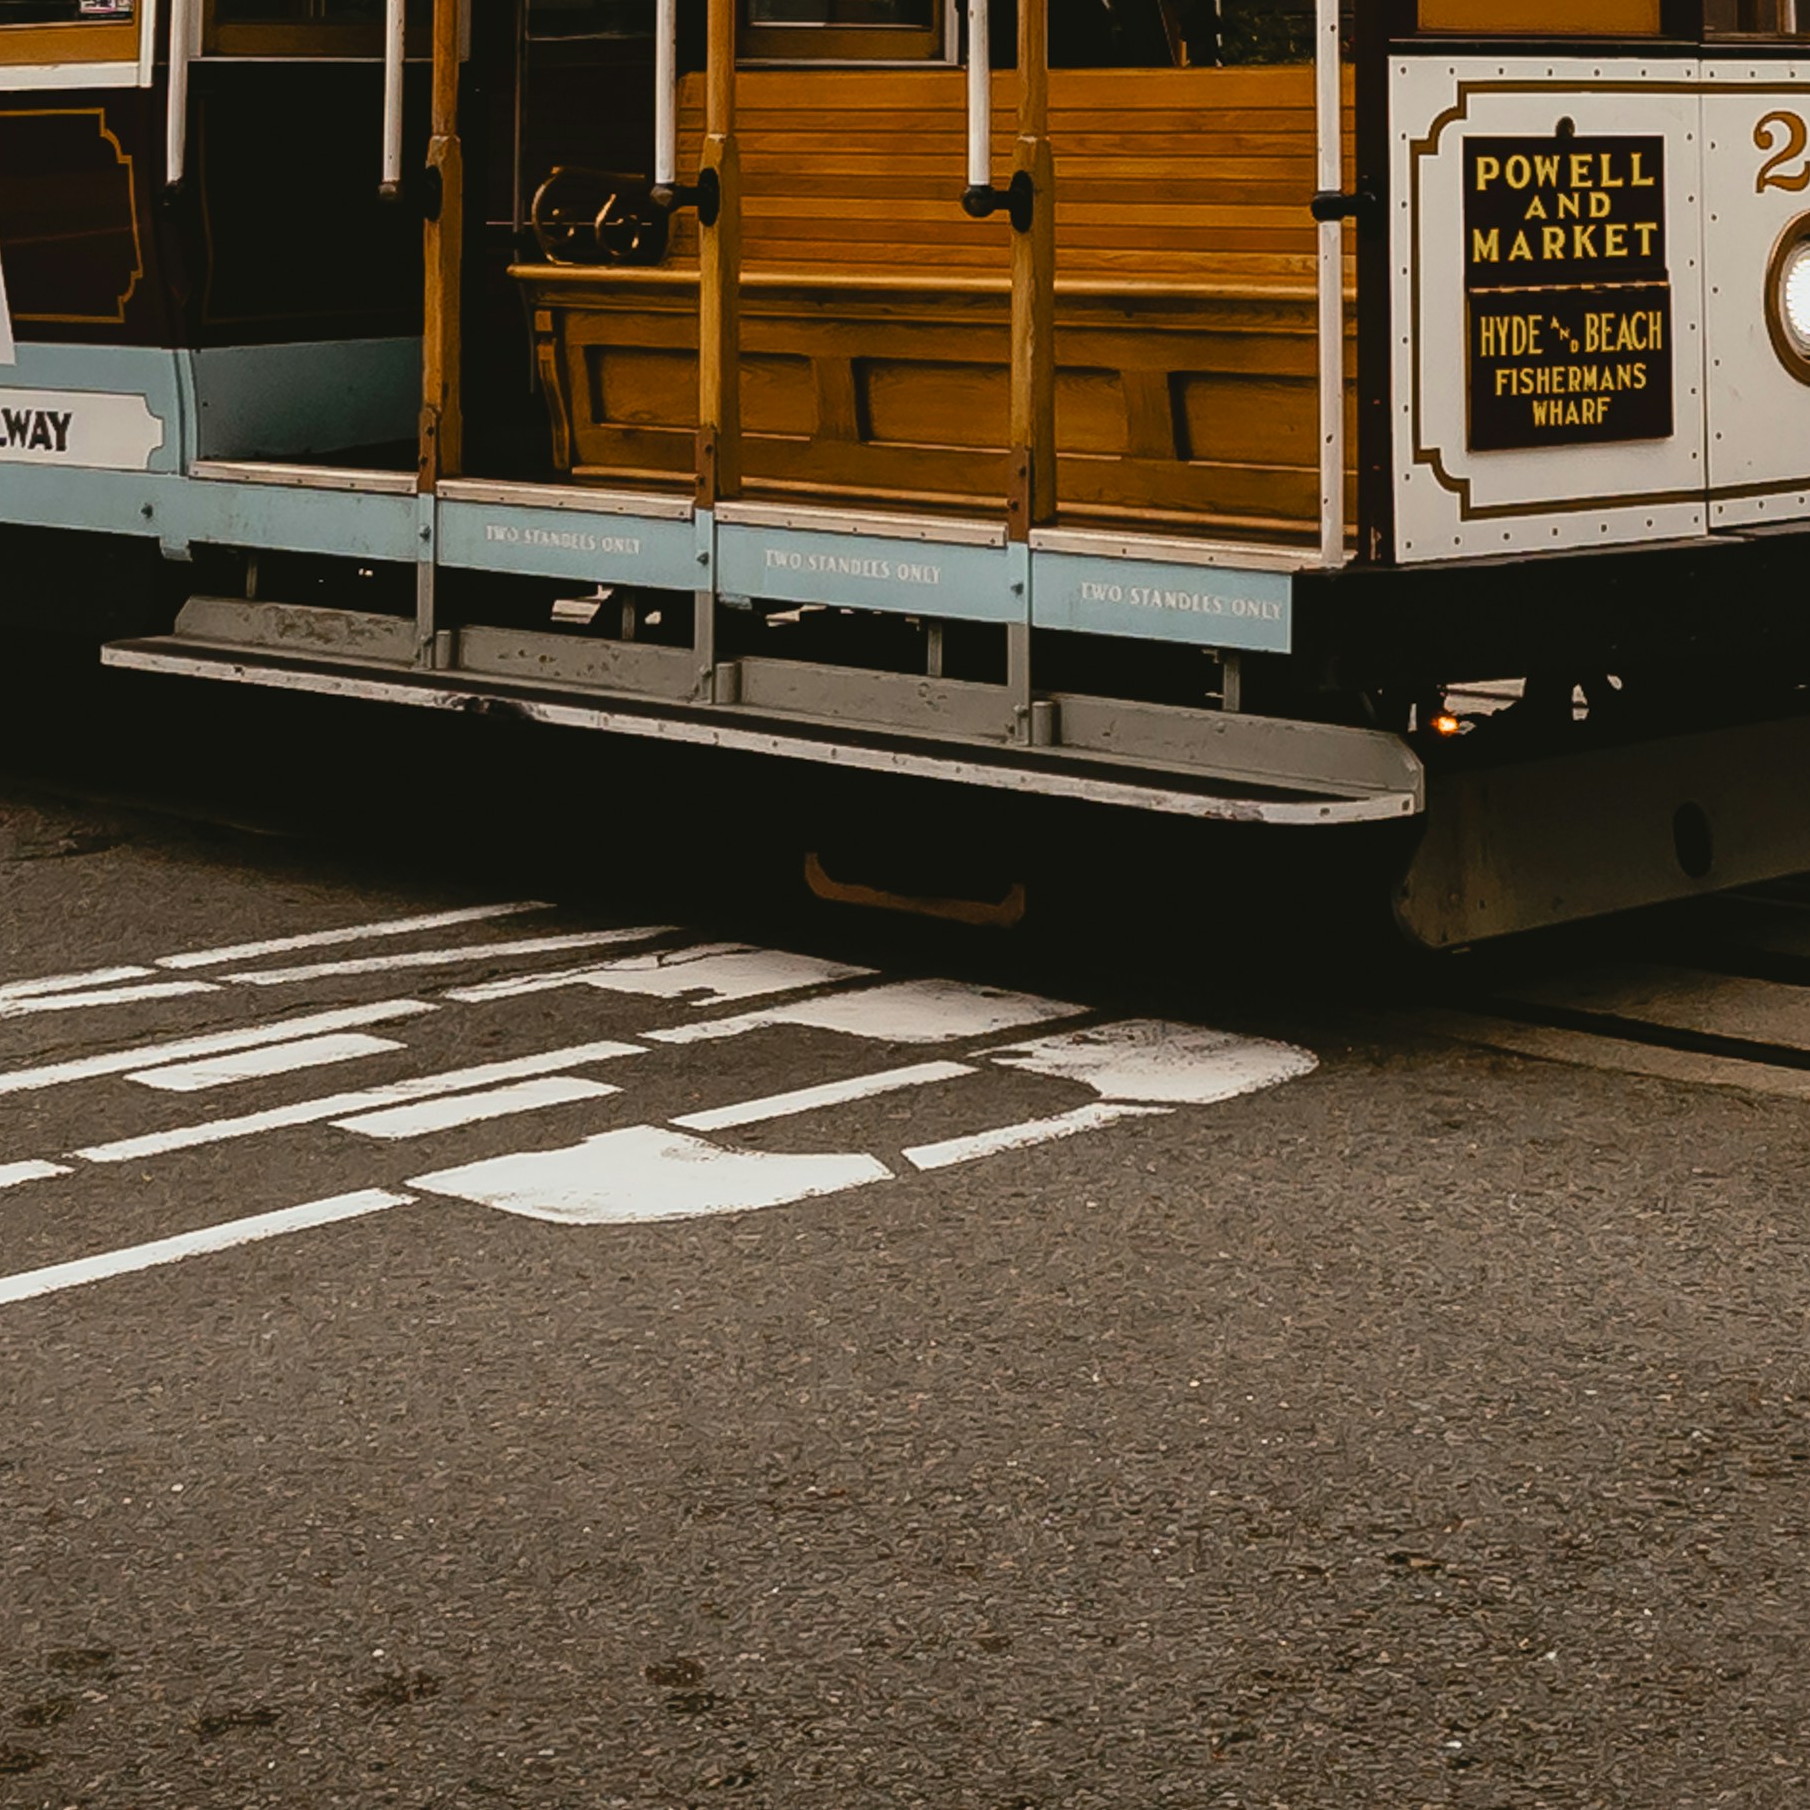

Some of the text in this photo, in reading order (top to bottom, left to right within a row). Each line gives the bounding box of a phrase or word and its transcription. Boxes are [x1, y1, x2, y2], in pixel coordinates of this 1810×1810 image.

[1475, 152, 1655, 191] POWELL
[1524, 191, 1612, 220] AND
[1472, 222, 1658, 263] MARKET
[1480, 310, 1662, 357] HYDE AND BEACH
[1495, 362, 1647, 396] FISHERMANS
[1532, 396, 1612, 428] WHARF
[486, 524, 519, 541] TWO
[601, 536, 640, 555] ONLY
[766, 549, 941, 585] TWO STANDEES ONLY
[1080, 581, 1283, 620] TWO STANDEES ONLY
